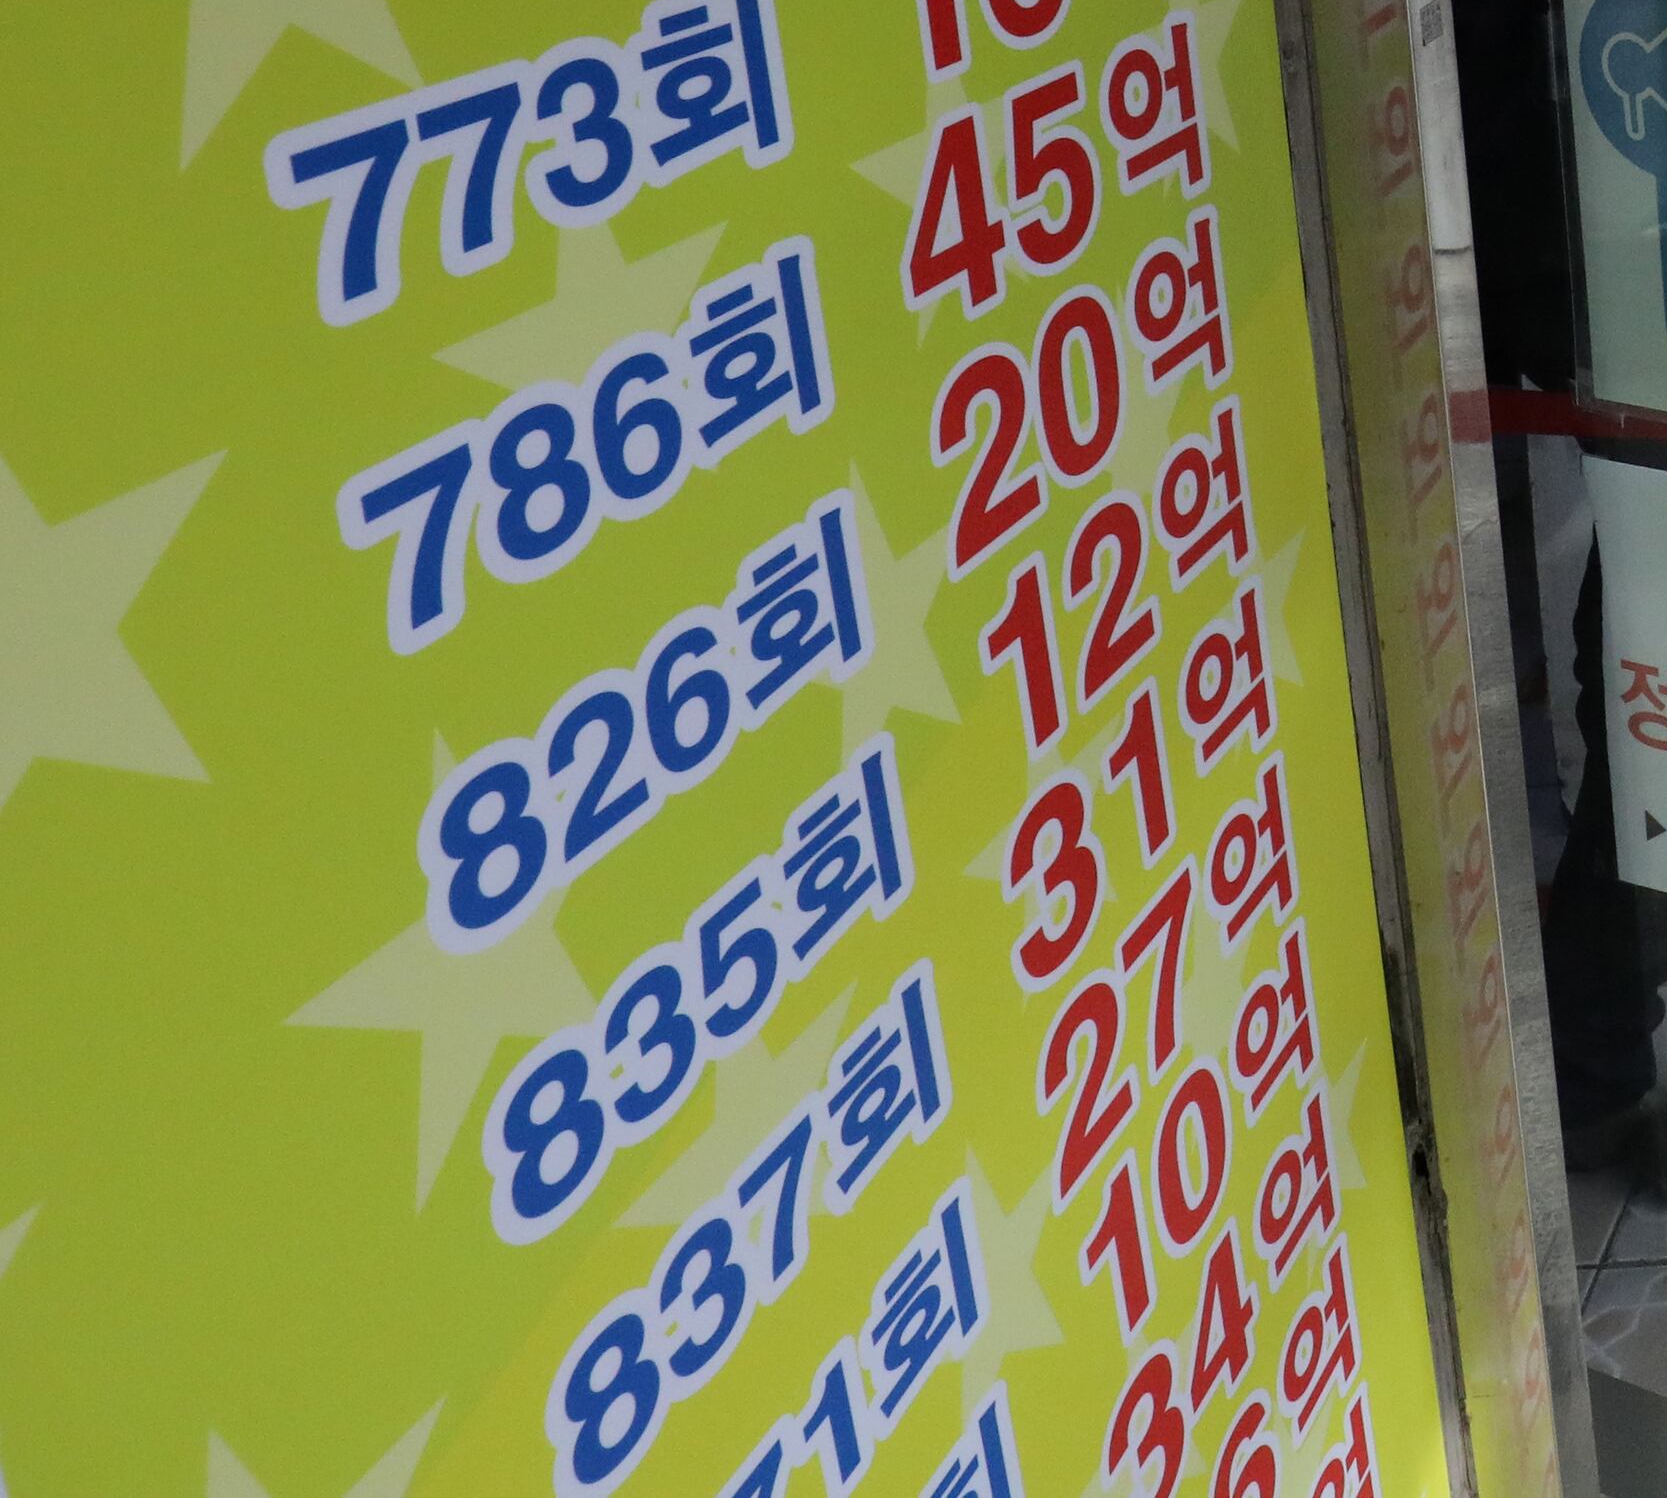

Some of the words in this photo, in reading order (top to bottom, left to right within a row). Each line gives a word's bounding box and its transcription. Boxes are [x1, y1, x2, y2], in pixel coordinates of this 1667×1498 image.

[361, 254, 821, 630] 786회
[908, 23, 1204, 306] 45억
[438, 509, 863, 932] 826회
[936, 218, 1228, 568] 20억
[502, 751, 903, 1221] 835회
[988, 408, 1249, 750] 12억
[562, 977, 939, 1487] 837회
[1010, 588, 1271, 979] 31억
[1044, 764, 1294, 1201] 27억
[1085, 932, 1314, 1333] 10억
[1106, 1093, 1337, 1498] 34억
